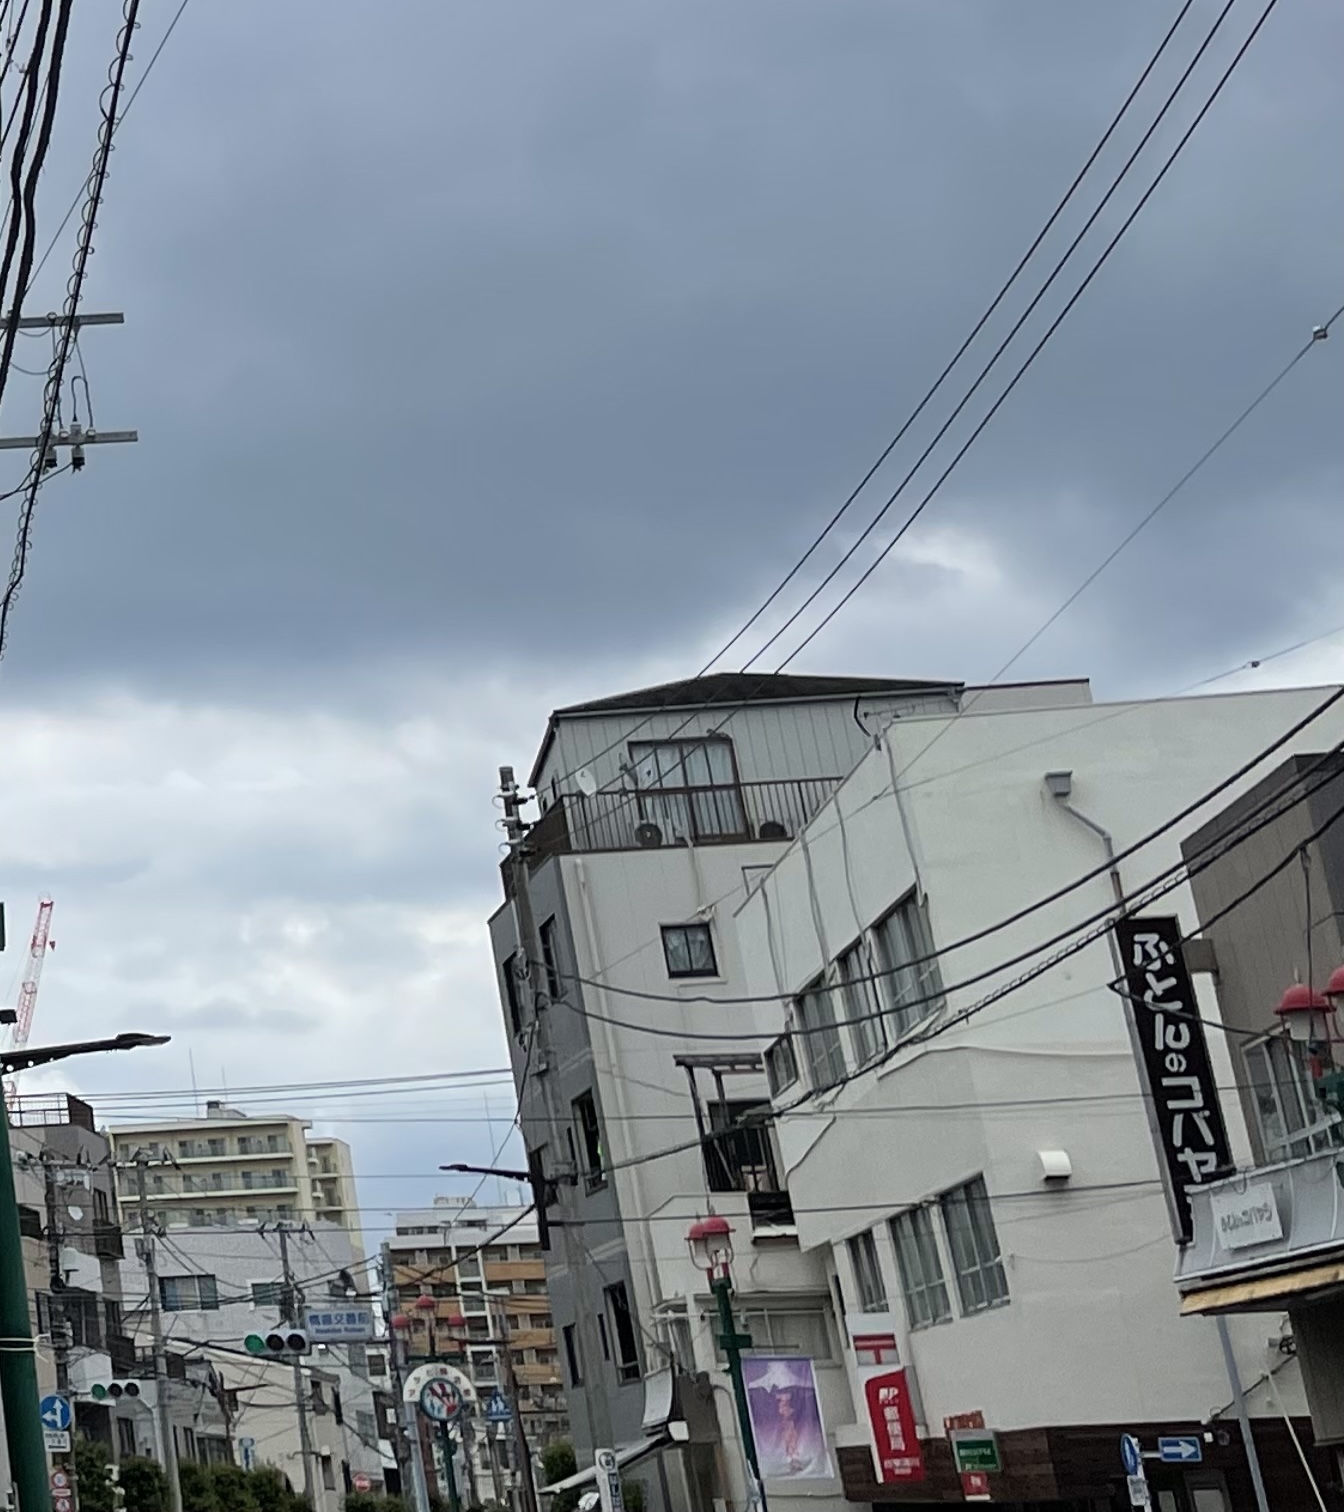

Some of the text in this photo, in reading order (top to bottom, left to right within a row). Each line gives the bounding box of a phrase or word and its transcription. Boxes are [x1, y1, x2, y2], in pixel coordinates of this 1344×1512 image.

[1133, 933, 1216, 1220] ふとんのコバヤ
